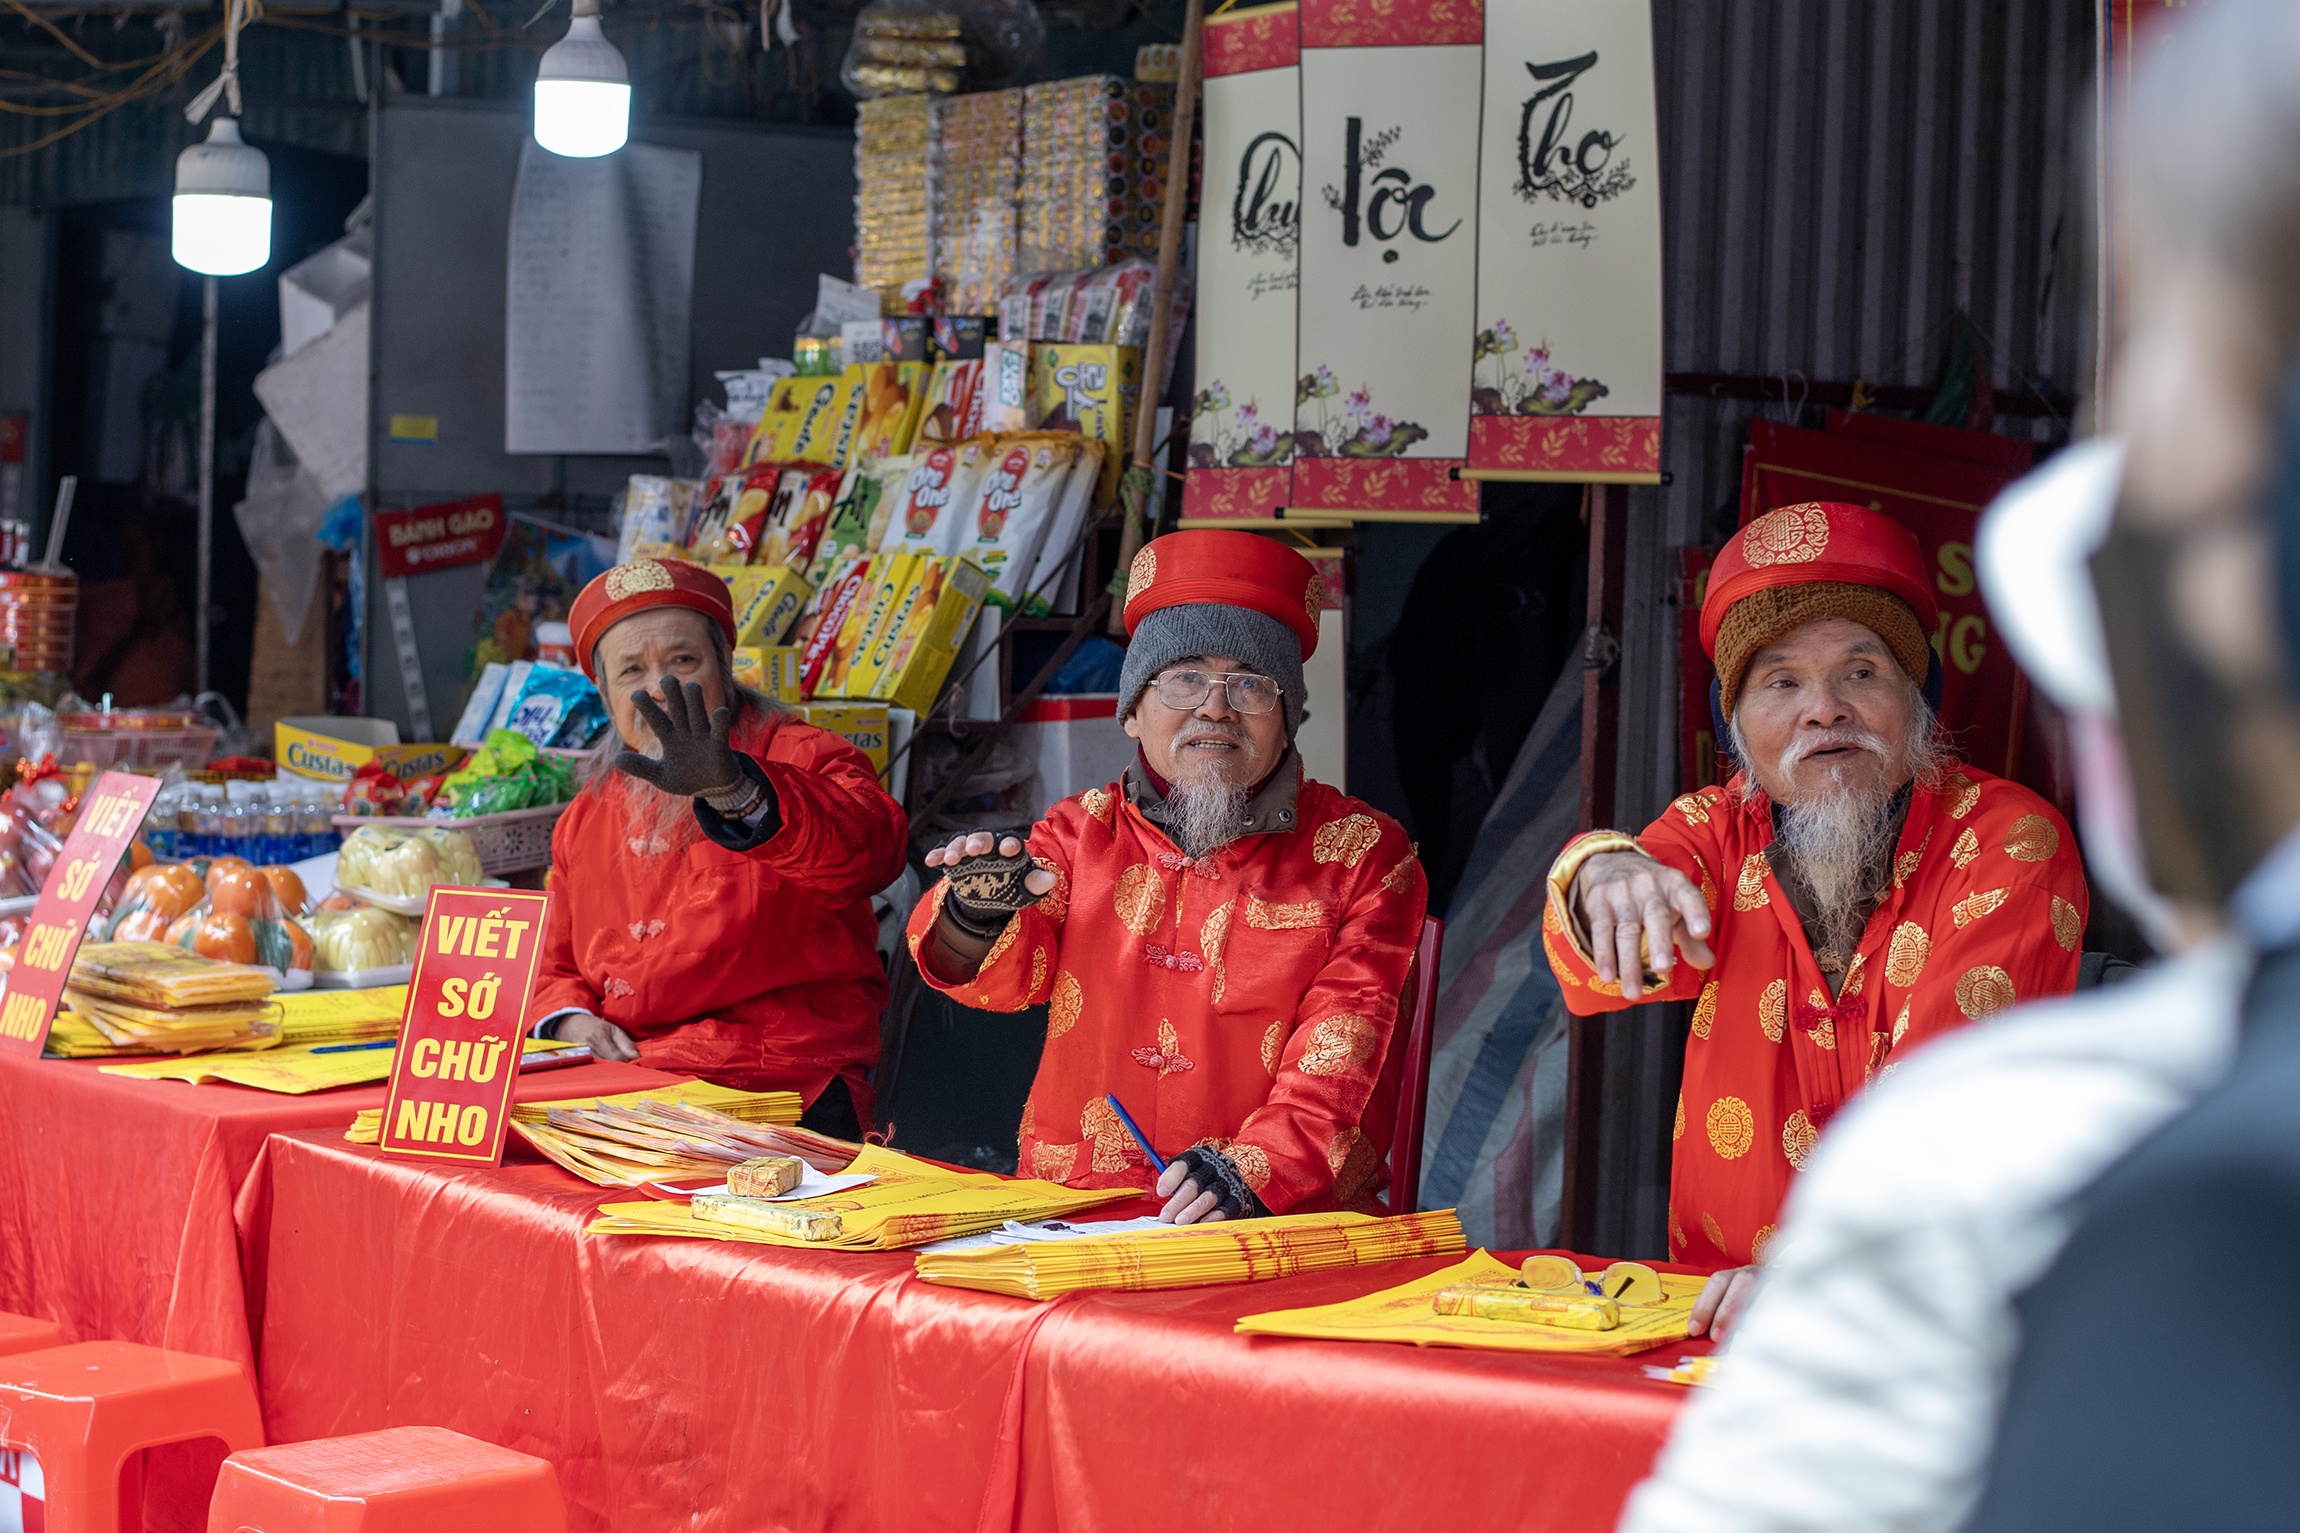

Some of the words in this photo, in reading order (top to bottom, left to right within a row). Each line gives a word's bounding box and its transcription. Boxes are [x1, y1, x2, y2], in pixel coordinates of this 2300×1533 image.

[908, 464, 945, 493] One
[914, 485, 951, 508] One
[982, 468, 1017, 497] One
[988, 488, 1022, 512] One
[83, 785, 142, 838] VIẾT
[57, 851, 102, 902] SỚ
[23, 918, 78, 972] CHỮ
[437, 907, 530, 960] VIẾT
[0, 991, 47, 1042] NHO
[437, 972, 502, 1020] SỚ
[410, 1035, 508, 1084] CHỮ
[394, 1099, 488, 1146] NHO
